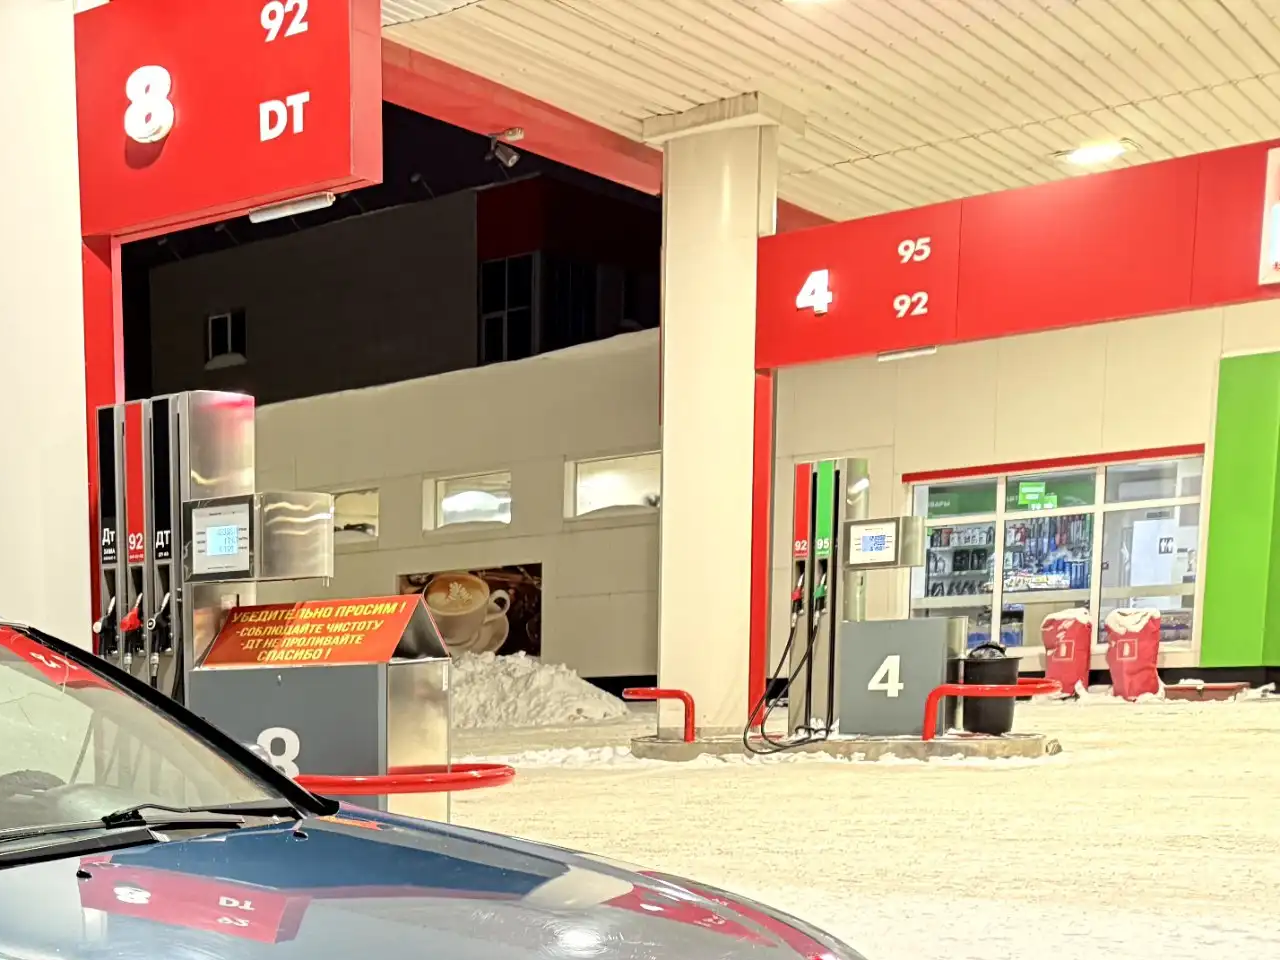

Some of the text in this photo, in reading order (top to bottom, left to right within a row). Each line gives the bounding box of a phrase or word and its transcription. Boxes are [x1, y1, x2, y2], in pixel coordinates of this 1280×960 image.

[260, 0, 308, 42] 92
[124, 65, 174, 143] 8
[259, 91, 310, 142] DT
[897, 237, 931, 263] 95
[796, 269, 833, 315] 4
[893, 292, 928, 318] 92
[129, 532, 144, 550] 92
[155, 530, 171, 549] ДТ
[795, 540, 808, 551] 92
[817, 539, 830, 550] 95
[232, 606, 334, 623] УБЕДИТЕЛЬНО
[334, 601, 399, 618] ПРОСИМ
[326, 619, 385, 633] ЧИСТОТУ
[263, 638, 280, 649] НЕ
[280, 633, 366, 649] ПРОЛИВАЙТЕ
[256, 647, 324, 662] СПАСИБО
[867, 655, 904, 697] 4
